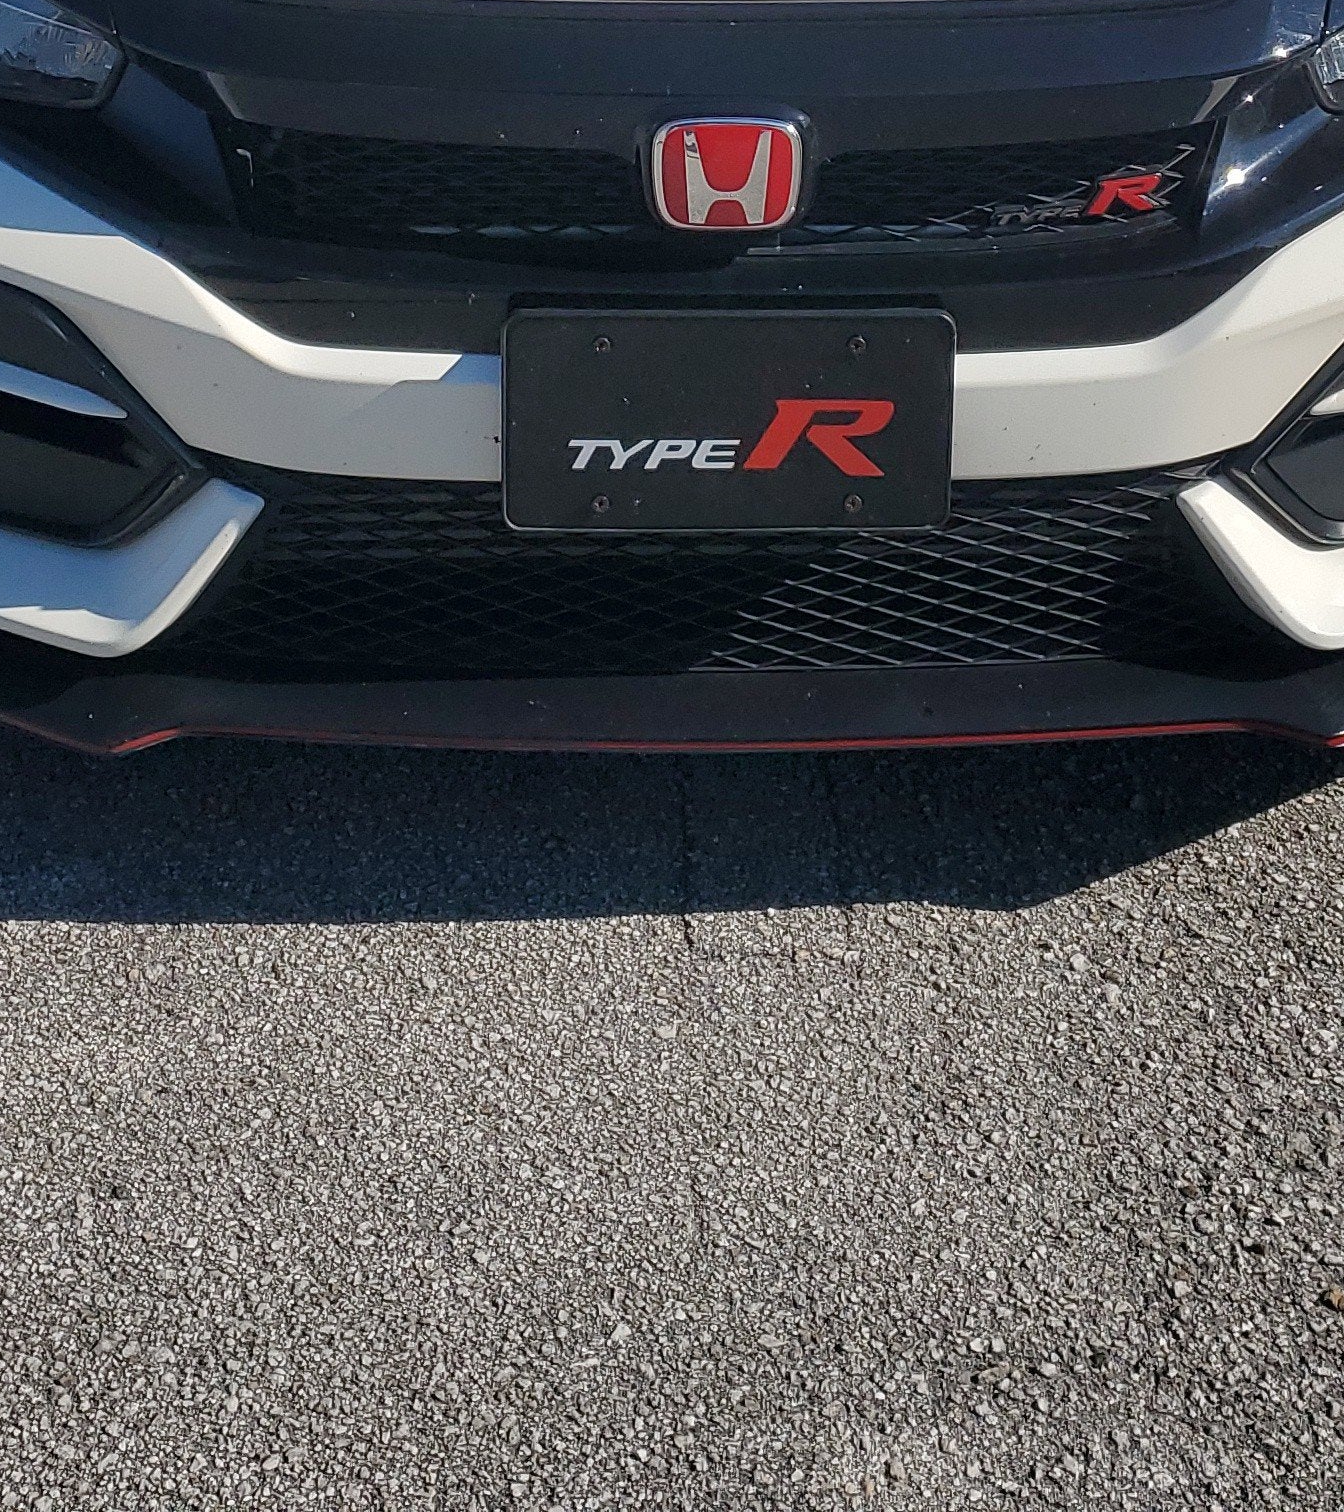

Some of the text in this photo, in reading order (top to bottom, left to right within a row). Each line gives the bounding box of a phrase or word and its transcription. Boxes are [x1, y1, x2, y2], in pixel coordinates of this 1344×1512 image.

[1086, 172, 1162, 216] R
[567, 399, 895, 477] TYPE R
